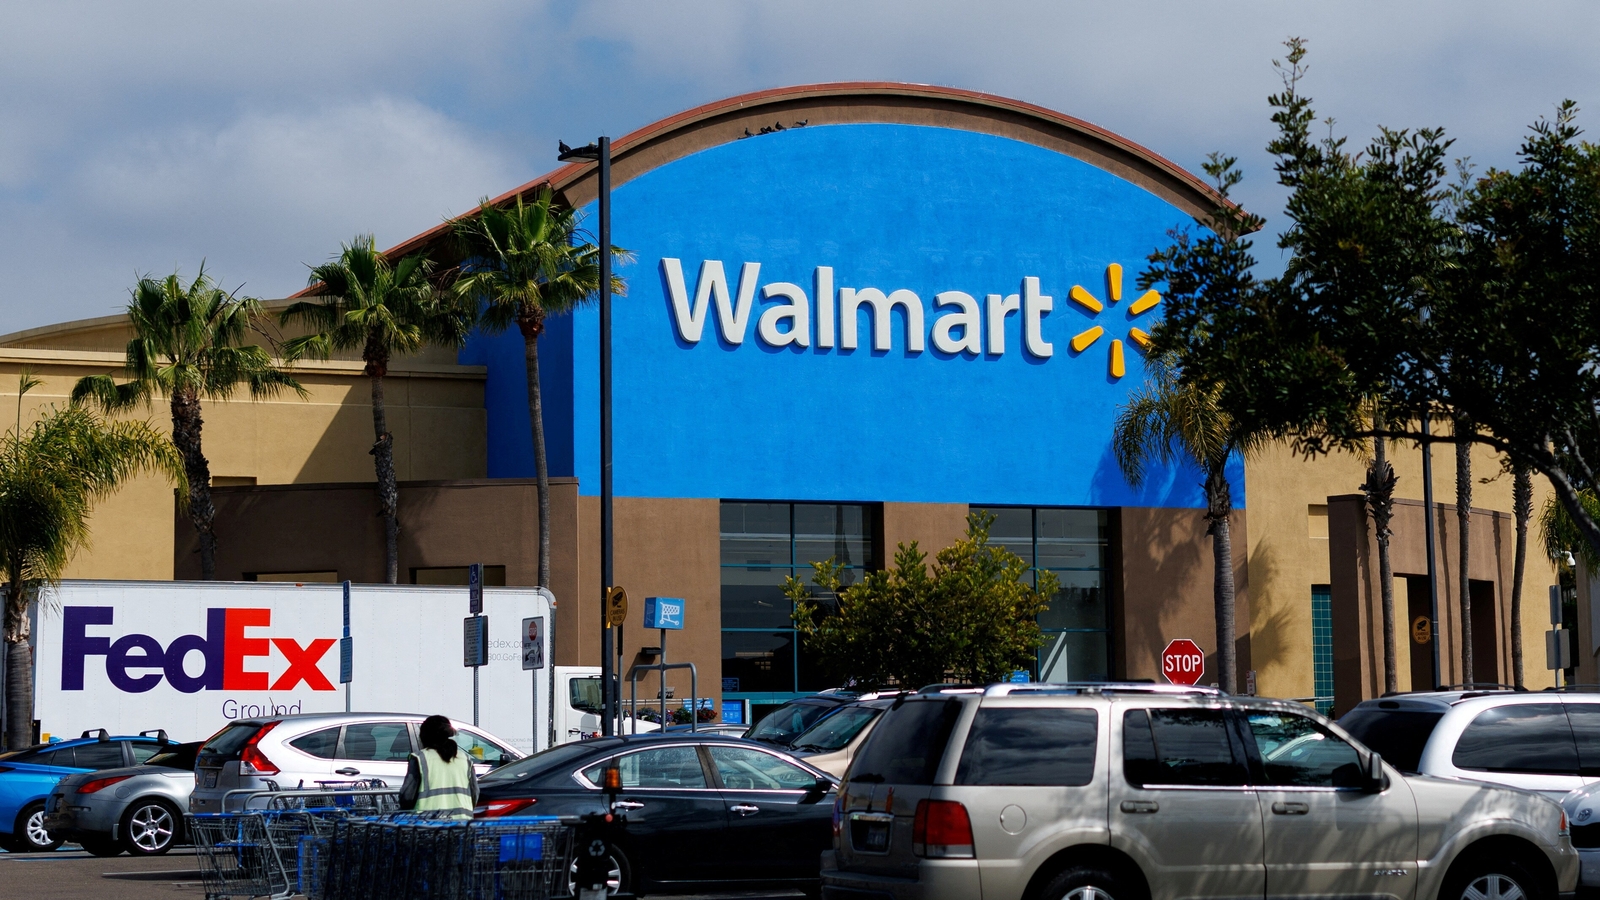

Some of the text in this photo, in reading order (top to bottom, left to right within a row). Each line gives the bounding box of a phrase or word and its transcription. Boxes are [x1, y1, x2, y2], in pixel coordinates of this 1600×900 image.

[662, 257, 1053, 358] Walmart
[61, 606, 338, 693] FedEx
[1165, 654, 1201, 673] STOP
[222, 699, 302, 720] Ground
